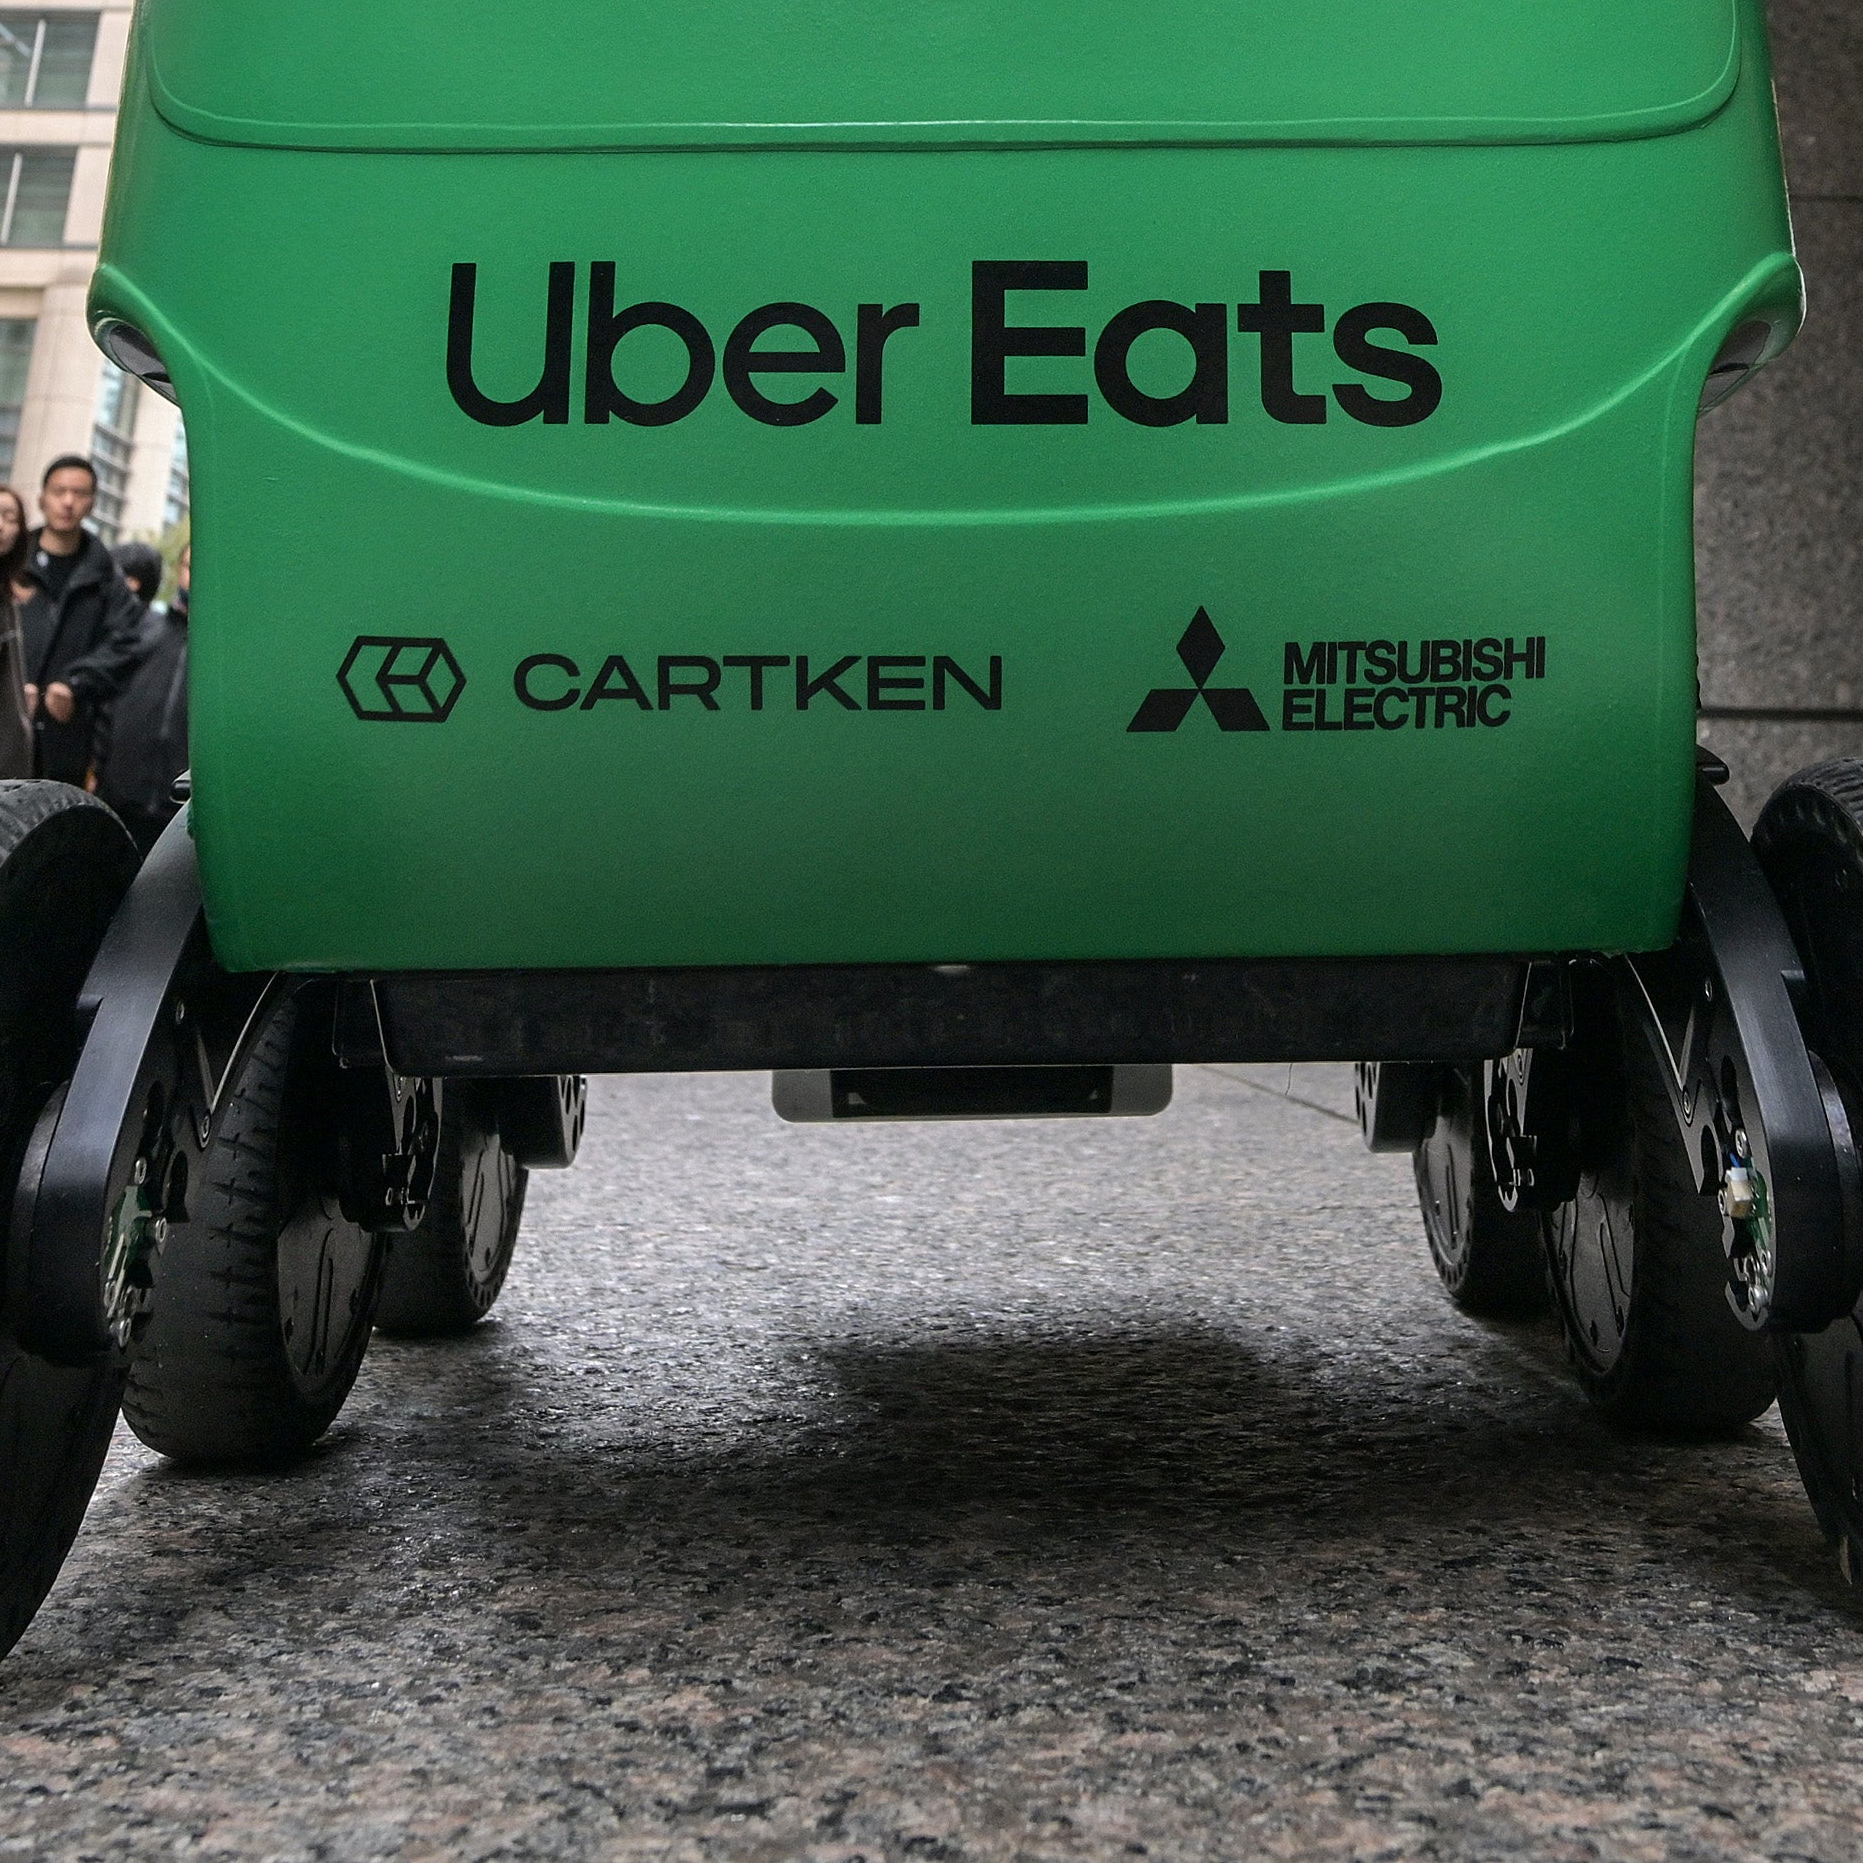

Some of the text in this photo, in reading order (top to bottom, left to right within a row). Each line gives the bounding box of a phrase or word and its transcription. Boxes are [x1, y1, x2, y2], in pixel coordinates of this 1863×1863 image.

[446, 259, 1443, 428] Uber Eats
[513, 653, 1003, 712] CARTKEN
[1283, 636, 1546, 686] MITSUBISHI
[1282, 683, 1512, 732] ELECTRIC
